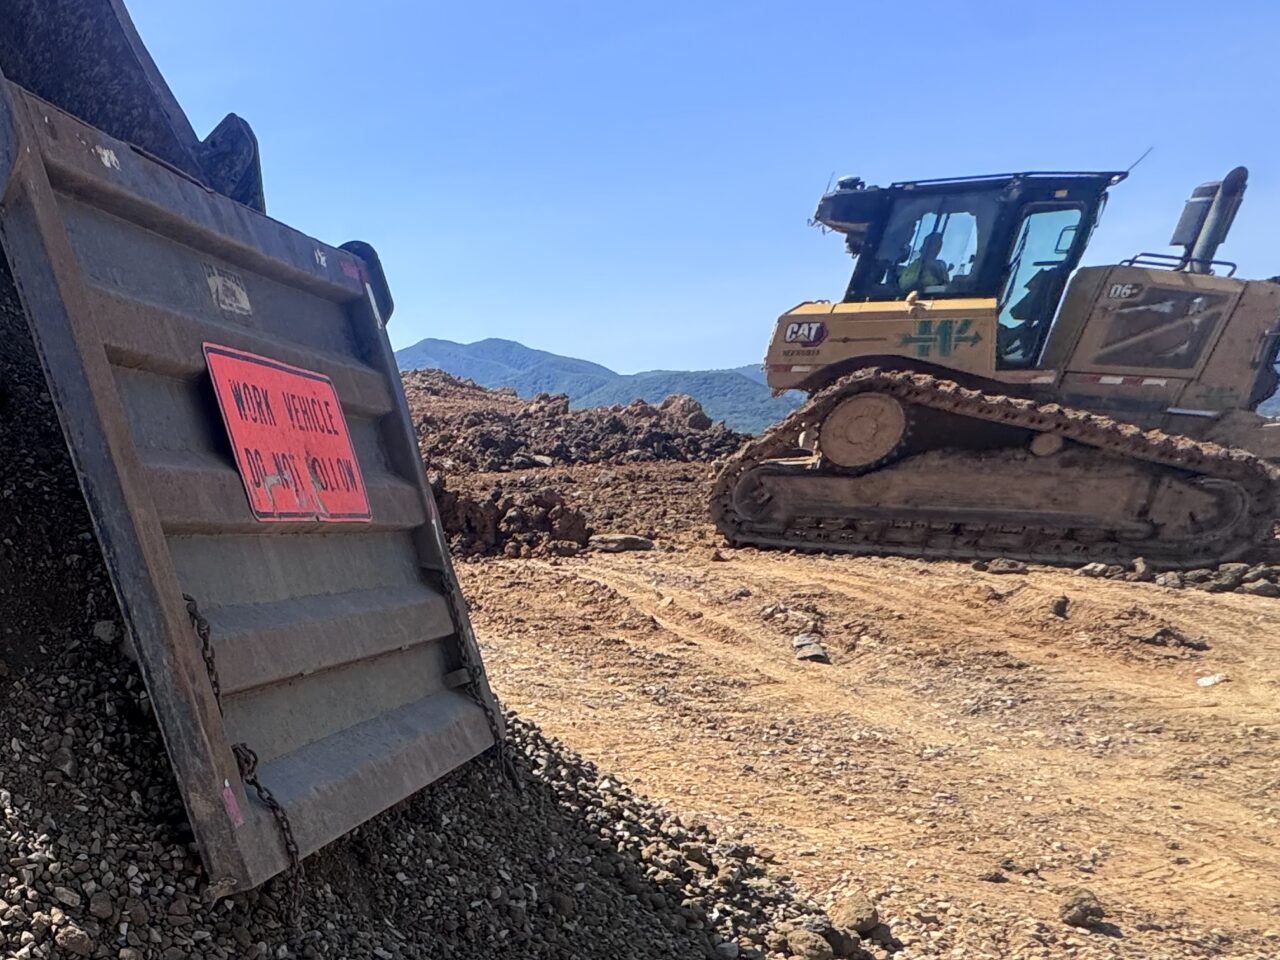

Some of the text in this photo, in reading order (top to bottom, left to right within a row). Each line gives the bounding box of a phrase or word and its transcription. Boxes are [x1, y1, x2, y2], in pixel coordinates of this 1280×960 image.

[785, 322, 821, 342] CAT
[229, 380, 339, 435] WORK VEHICLE
[244, 448, 358, 494] DO NOT OLLOW
